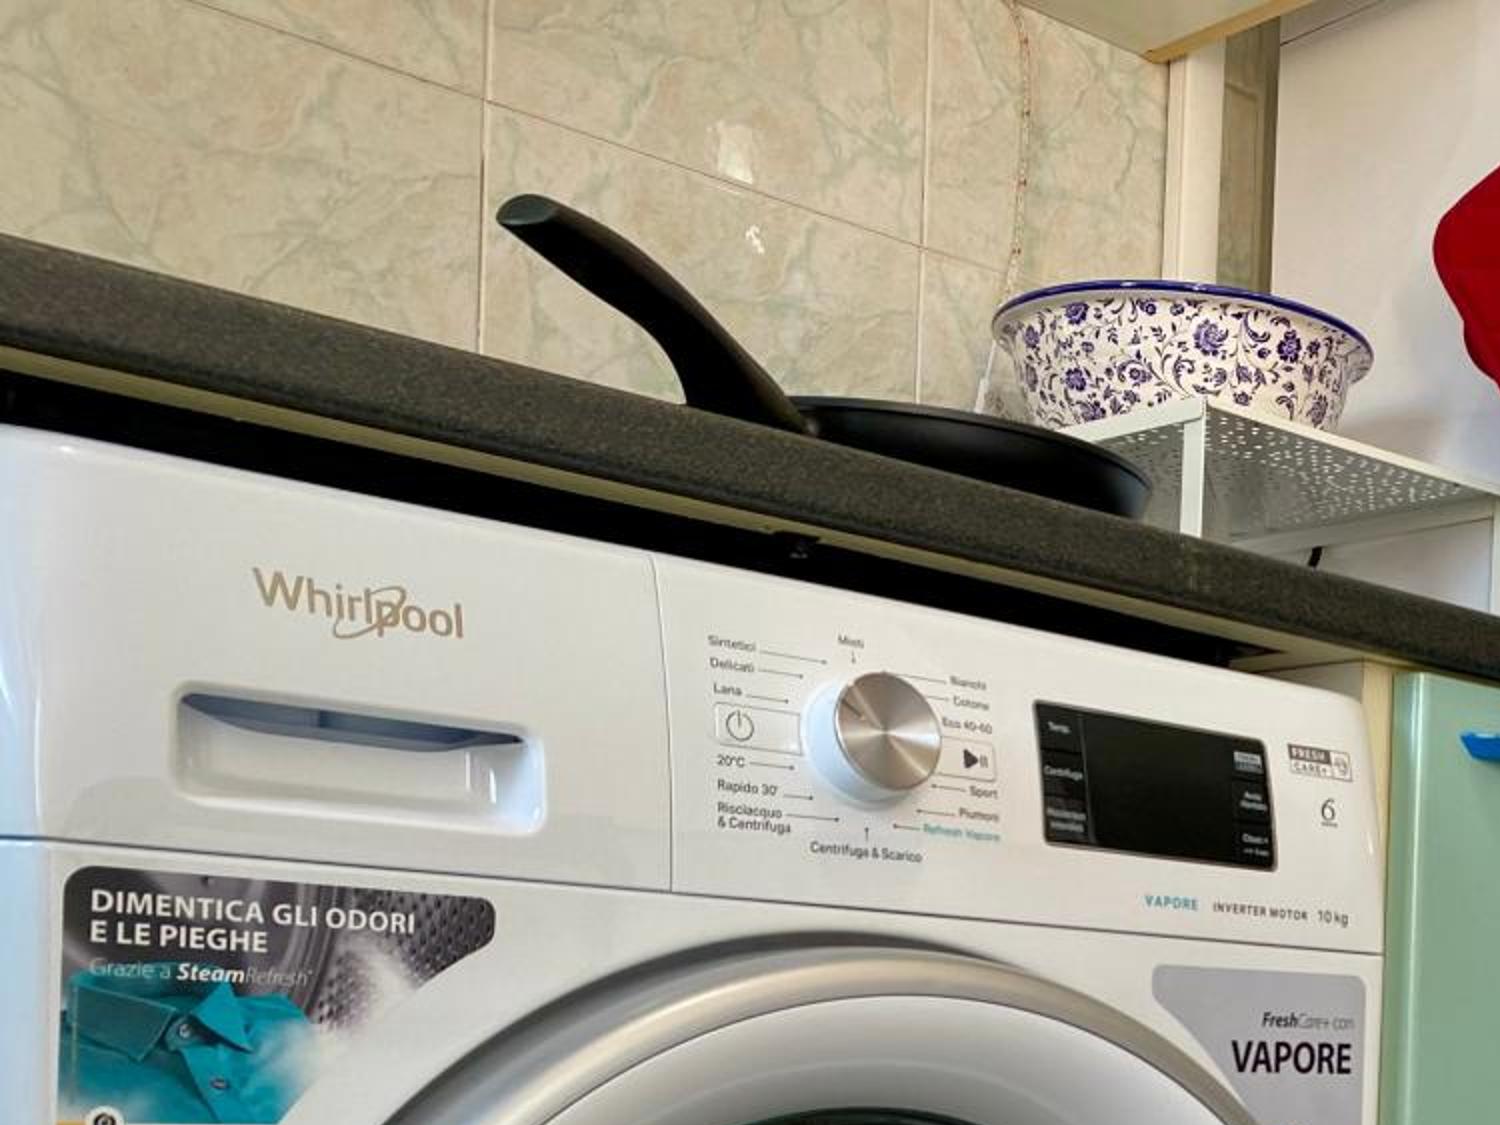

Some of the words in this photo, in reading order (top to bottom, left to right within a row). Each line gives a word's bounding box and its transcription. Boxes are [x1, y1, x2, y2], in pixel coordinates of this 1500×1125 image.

[252, 566, 463, 639] Whirlpool
[707, 634, 757, 652] Sintetici
[709, 656, 755, 672] Delicati
[713, 682, 742, 696] Lana
[1291, 746, 1327, 763] FRESH
[717, 778, 759, 794] Rapido
[969, 785, 999, 801] Sport
[717, 801, 783, 819] Risciacquo
[717, 816, 727, 829] &
[728, 816, 791, 836] Centrifuga
[810, 841, 869, 860] Centrifuga
[871, 847, 880, 860] &
[881, 847, 922, 863] Scarico
[90, 889, 264, 924] DIMENTICA
[271, 902, 318, 927] GLI
[325, 907, 415, 935] ODORI
[1143, 894, 1199, 912] VAPORE
[1213, 901, 1267, 918] INVERTER
[1269, 907, 1309, 922] MOTOR
[89, 920, 108, 943] E
[116, 921, 151, 946] LE
[159, 925, 269, 953] PIEGHE
[89, 957, 154, 979] Grazie
[159, 964, 172, 980] a
[1231, 1039, 1353, 1075] VAPORE
